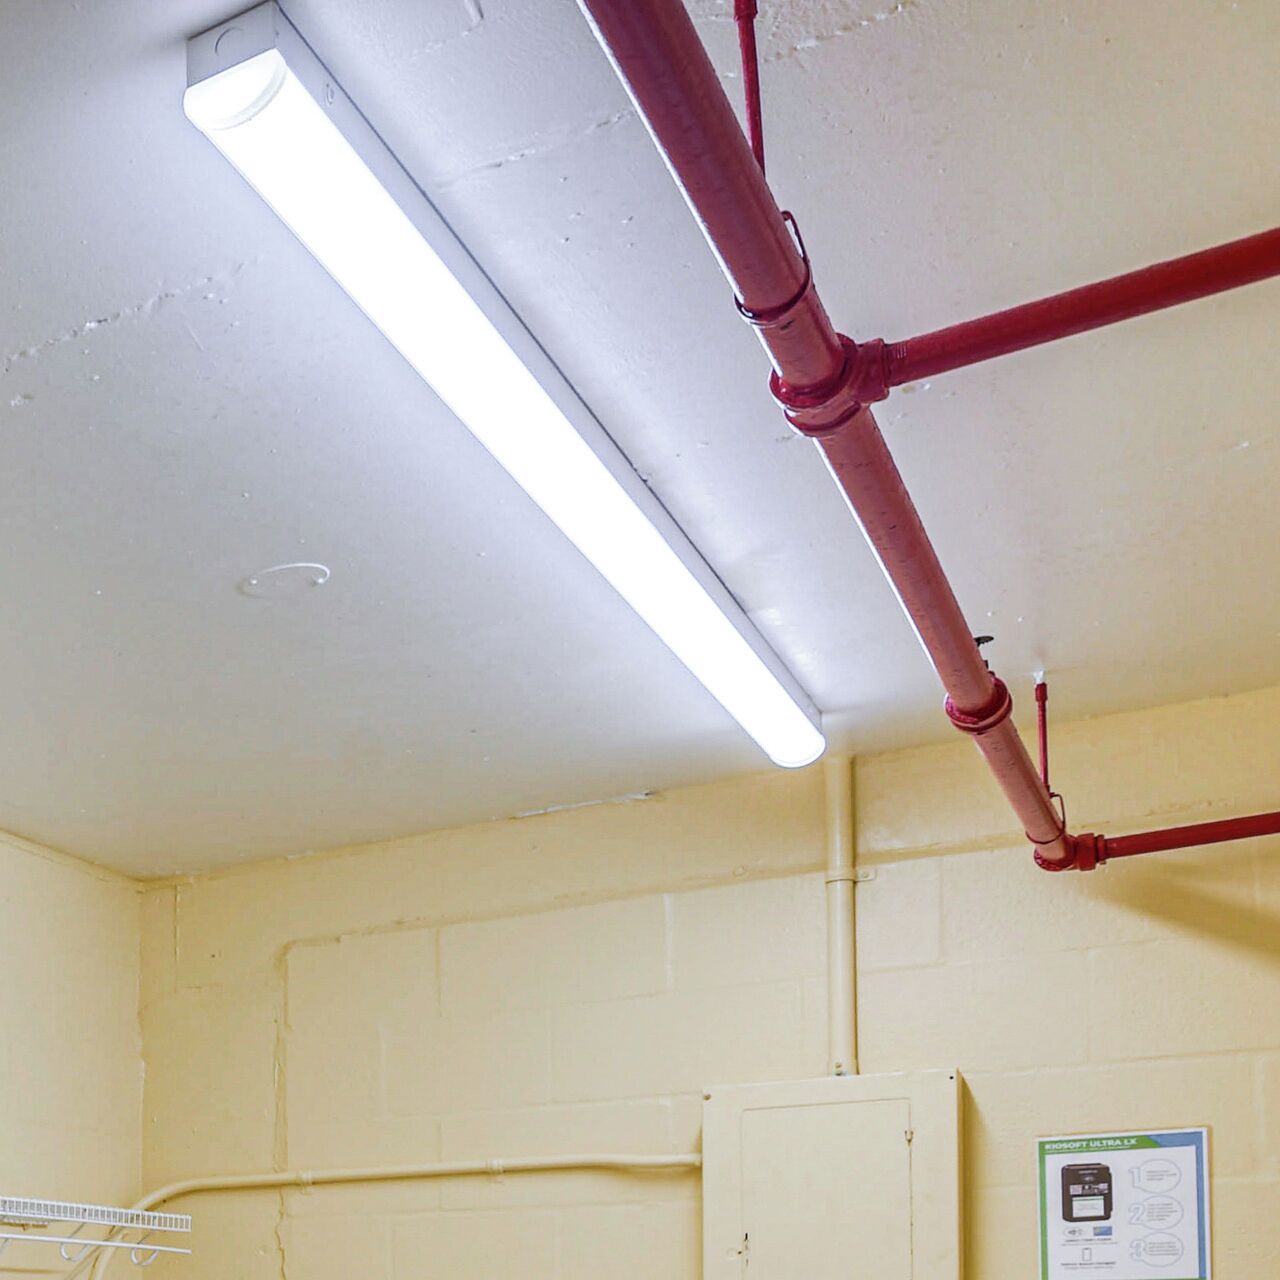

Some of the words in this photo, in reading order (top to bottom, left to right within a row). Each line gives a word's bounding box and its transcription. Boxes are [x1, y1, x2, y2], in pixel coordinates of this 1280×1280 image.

[1044, 1141, 1087, 1150] KIOSOFT
[1090, 1139, 1122, 1147] ULTRA
[1128, 1167, 1141, 1188] 1
[1128, 1202, 1145, 1225] 2
[1130, 1239, 1146, 1261] 3
